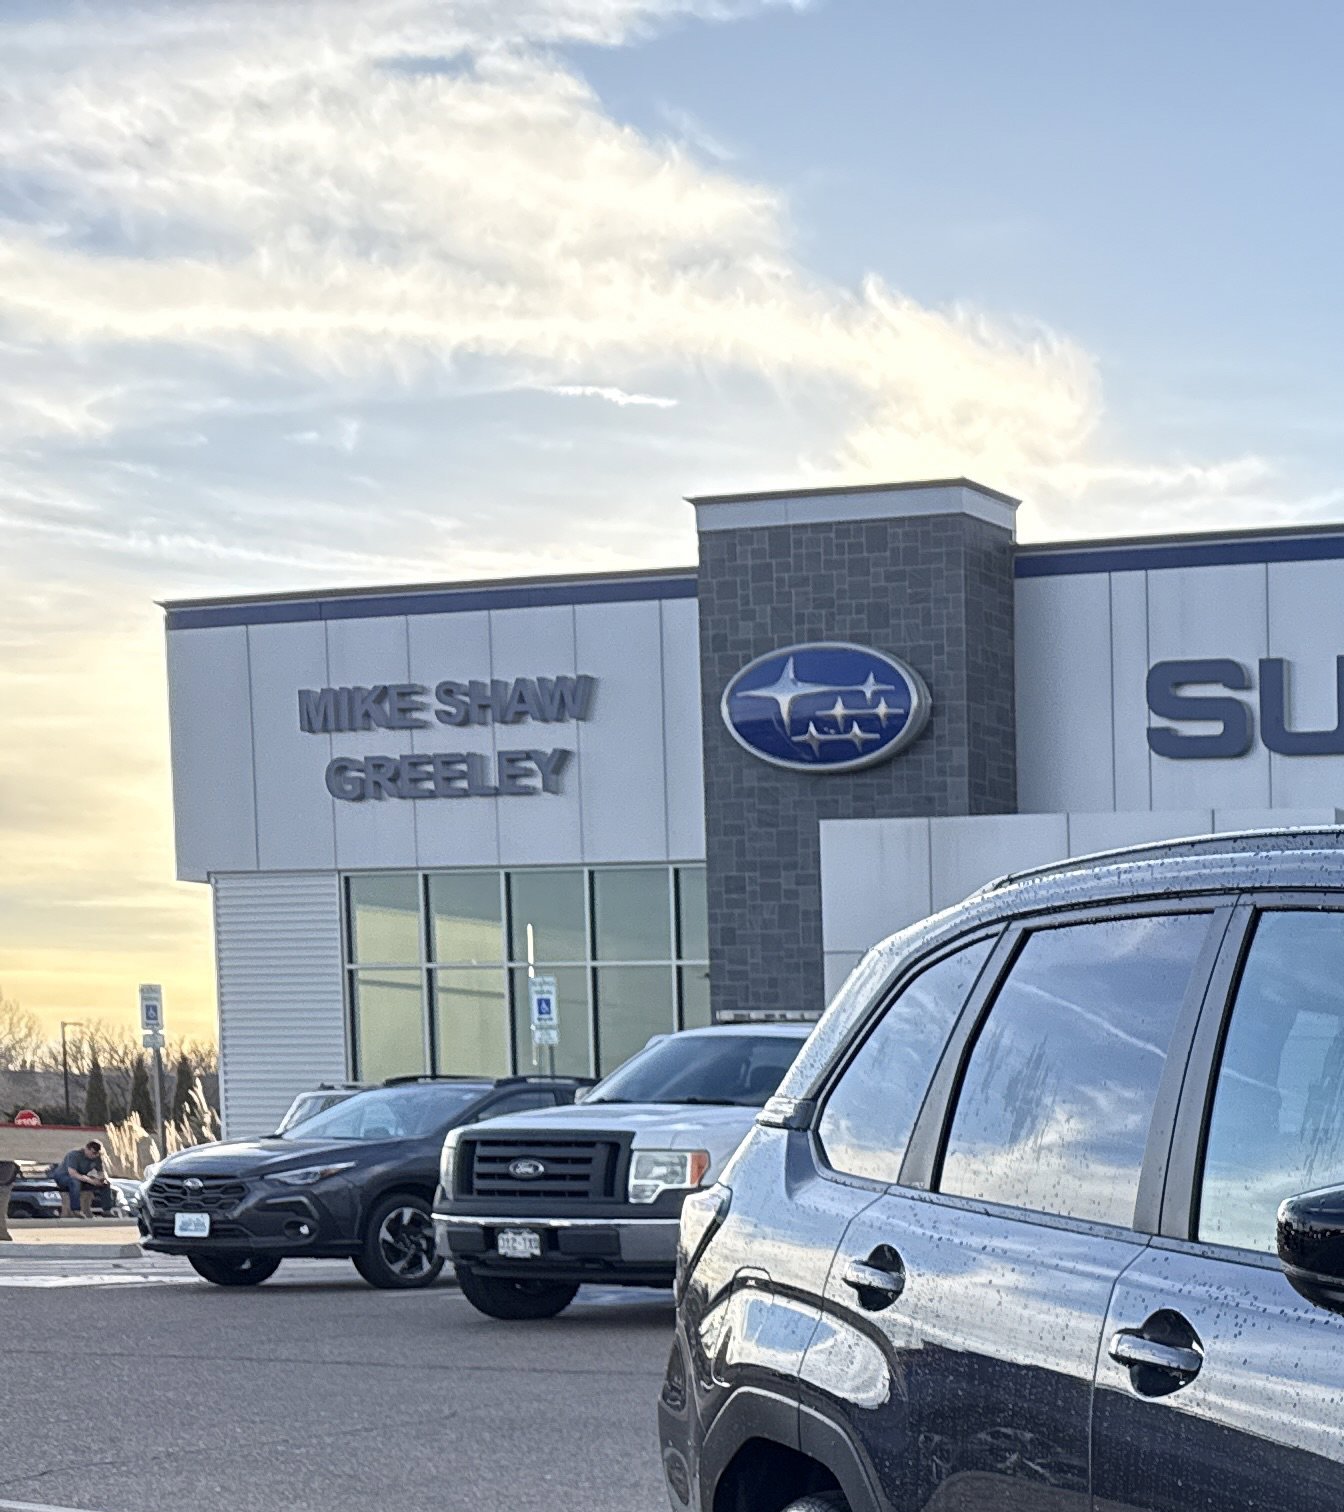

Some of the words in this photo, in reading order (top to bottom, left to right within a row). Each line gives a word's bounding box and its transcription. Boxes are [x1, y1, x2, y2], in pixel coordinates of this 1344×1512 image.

[298, 683, 434, 733] MIKE
[434, 674, 600, 727] SHAW
[325, 747, 575, 802] GREELEY
